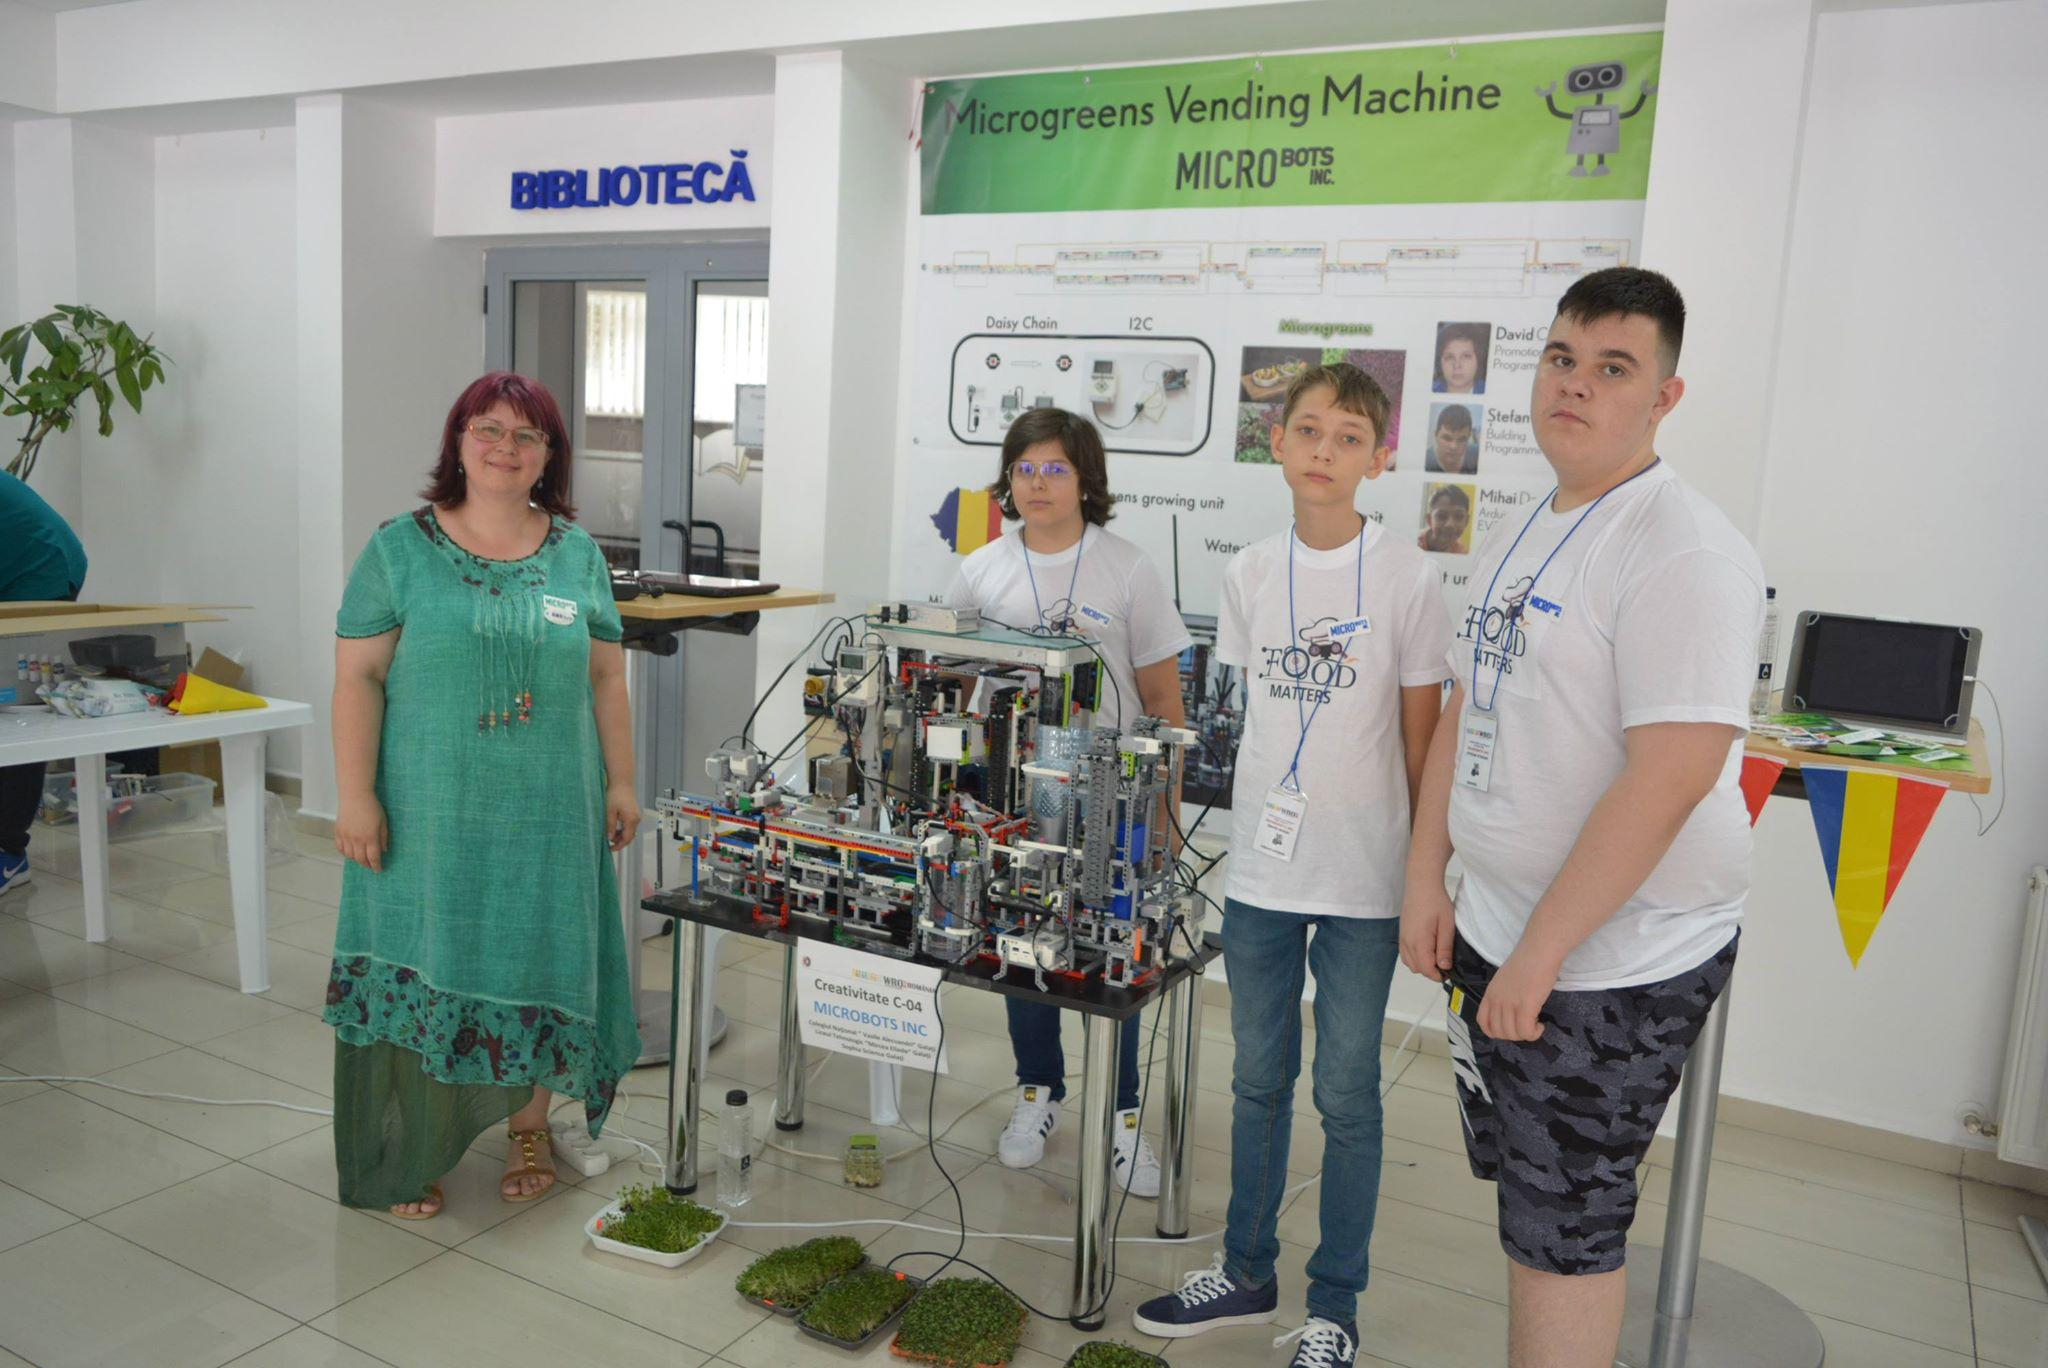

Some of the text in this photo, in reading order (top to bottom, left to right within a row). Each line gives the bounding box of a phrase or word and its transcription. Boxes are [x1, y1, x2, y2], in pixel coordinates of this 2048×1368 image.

[944, 70, 1501, 140] Microgreens Vending Machine
[1176, 146, 1334, 190] MICRO BOTS
[1309, 169, 1335, 185] INC.
[510, 148, 756, 210] BIBLIOTECĂ
[986, 315, 1058, 332] Daisy Chain
[1128, 317, 1153, 331] I2C
[1278, 318, 1374, 340] Microgreens
[1495, 326, 1534, 341] David
[1486, 428, 1527, 443] Building
[1141, 493, 1195, 512] growing
[1200, 496, 1225, 510] unit
[1480, 488, 1517, 505] Mihai
[1330, 622, 1356, 636] MICRO
[1258, 646, 1356, 689] FOOD
[1269, 684, 1332, 705] MATTERS
[814, 978, 922, 1012] Creativitate C-04
[813, 1000, 928, 1037] MICROBOTS INC
